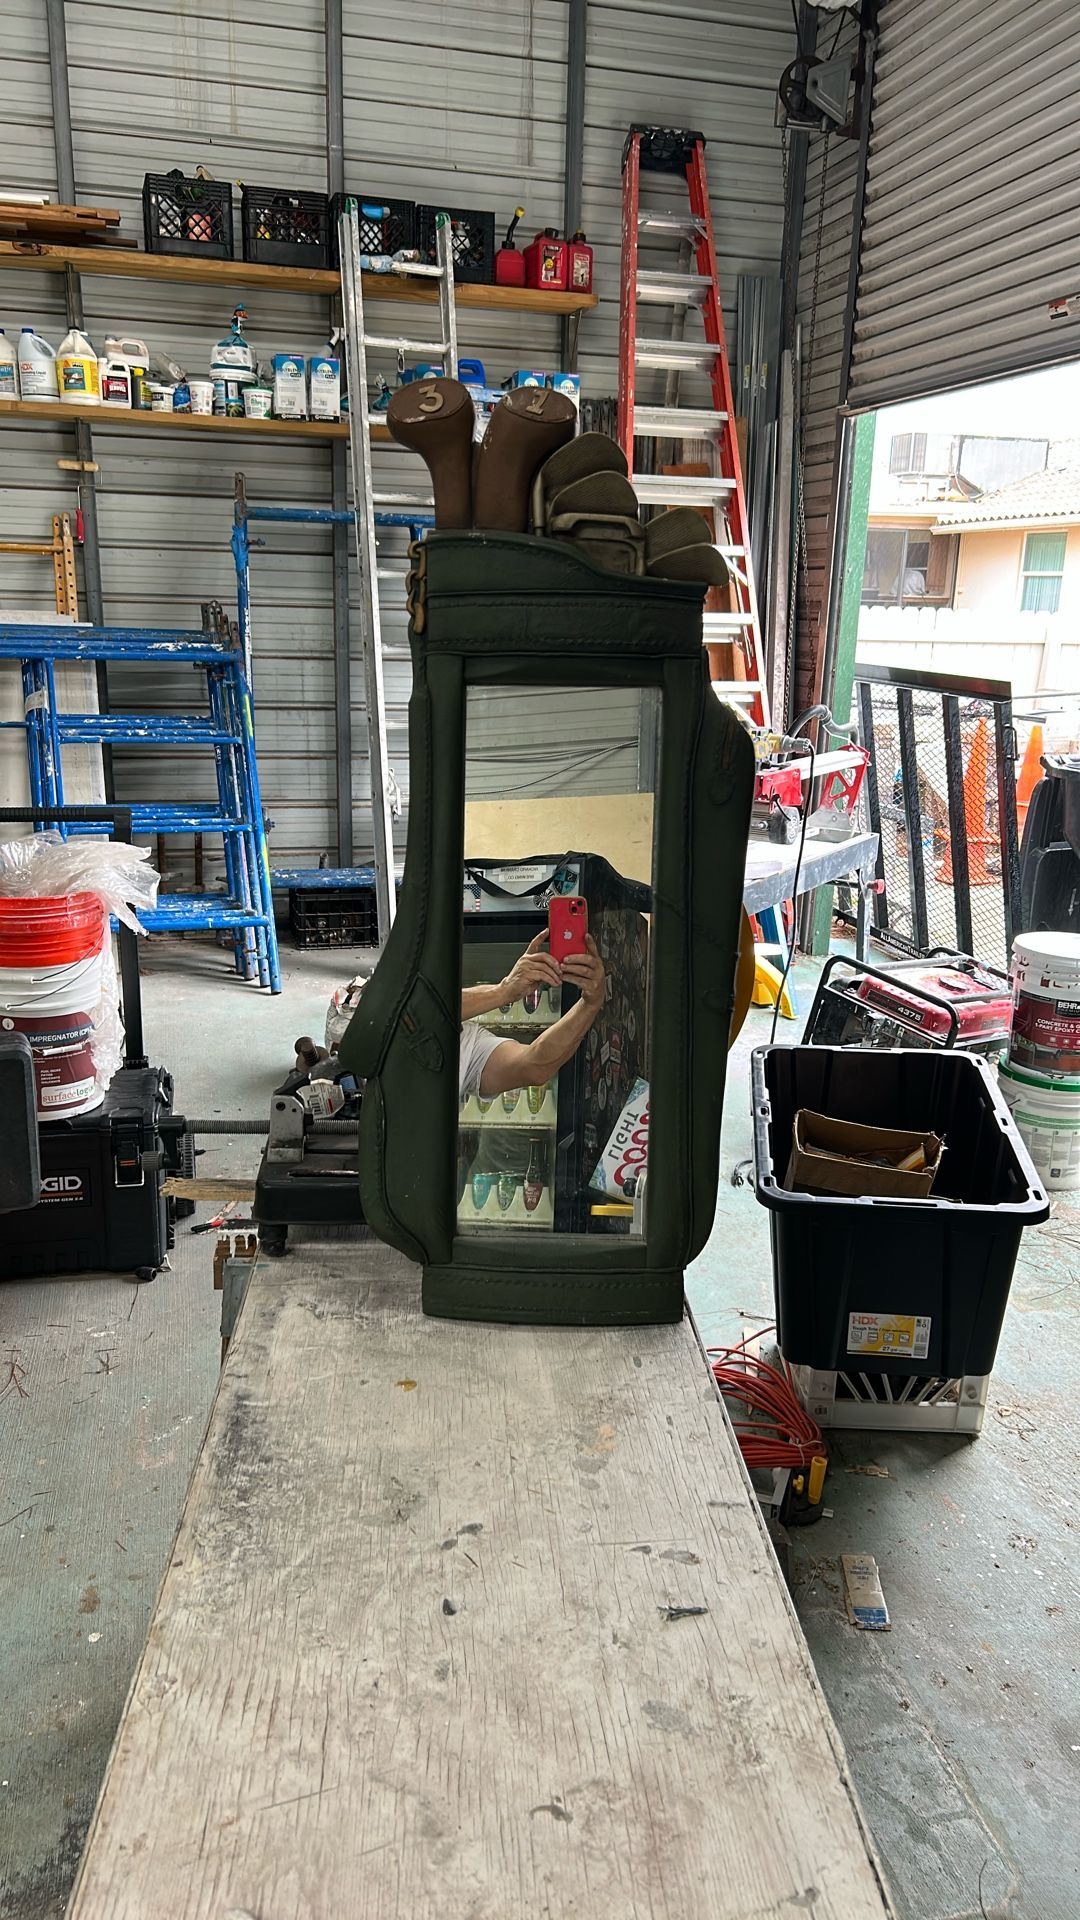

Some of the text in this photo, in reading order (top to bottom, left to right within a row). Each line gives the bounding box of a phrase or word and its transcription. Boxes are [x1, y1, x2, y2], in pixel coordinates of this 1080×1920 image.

[419, 384, 444, 412] 3
[1058, 1001, 1077, 1009] BEHR
[897, 1007, 922, 1021] 4375
[1037, 1018, 1068, 1028] CONCRETE
[29, 1030, 79, 1043] IMPREGNATOR
[852, 1316, 879, 1325] HDX
